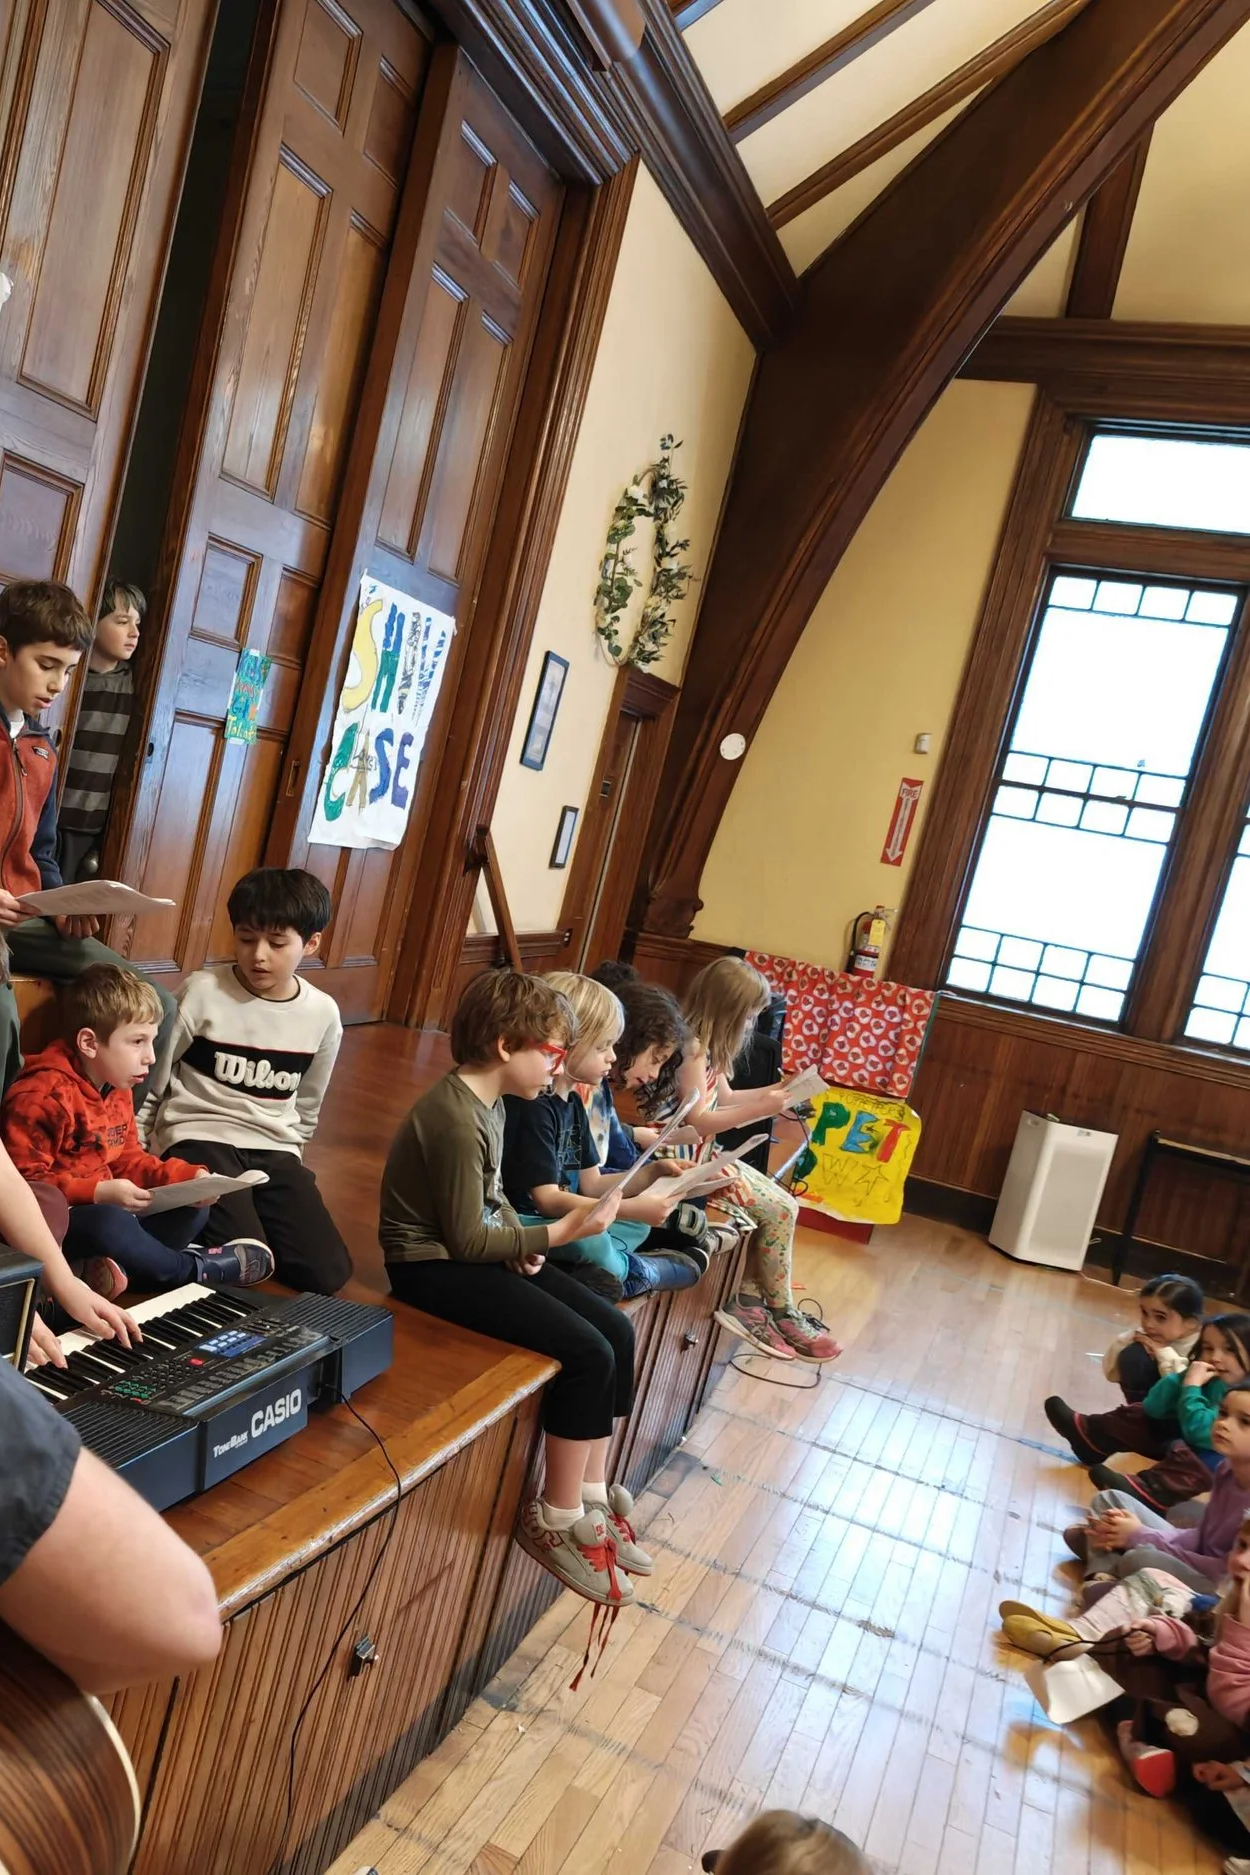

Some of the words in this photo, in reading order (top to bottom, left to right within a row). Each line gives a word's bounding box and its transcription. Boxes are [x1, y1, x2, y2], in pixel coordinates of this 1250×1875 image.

[323, 722, 415, 822] CASE
[214, 1051, 302, 1092] Wilson
[811, 1101, 911, 1164] PET
[251, 1388, 302, 1438] CASIO
